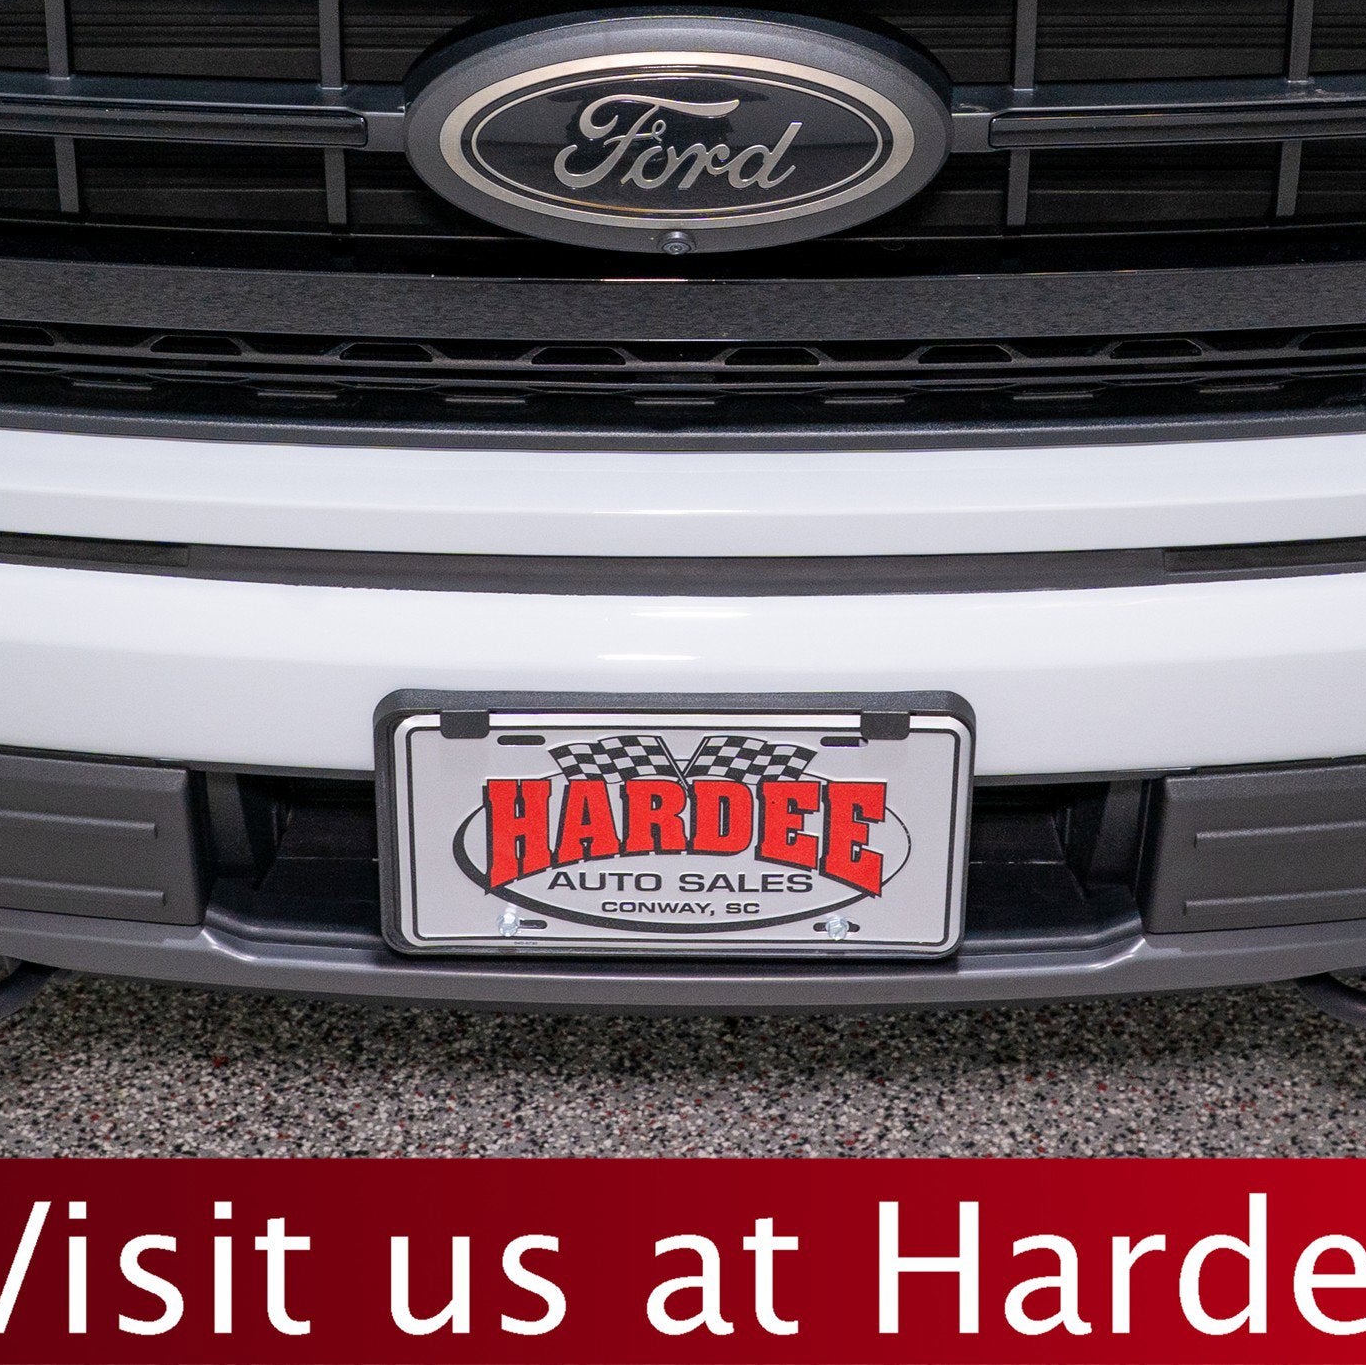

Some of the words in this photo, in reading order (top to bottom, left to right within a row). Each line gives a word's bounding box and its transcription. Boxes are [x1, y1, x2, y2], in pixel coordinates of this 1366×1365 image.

[553, 93, 804, 191] Ford
[485, 778, 887, 897] HARDEE
[547, 871, 663, 892] AUTO
[678, 871, 813, 893] SALES
[601, 900, 715, 916] CONWAY,
[726, 900, 760, 914] SC
